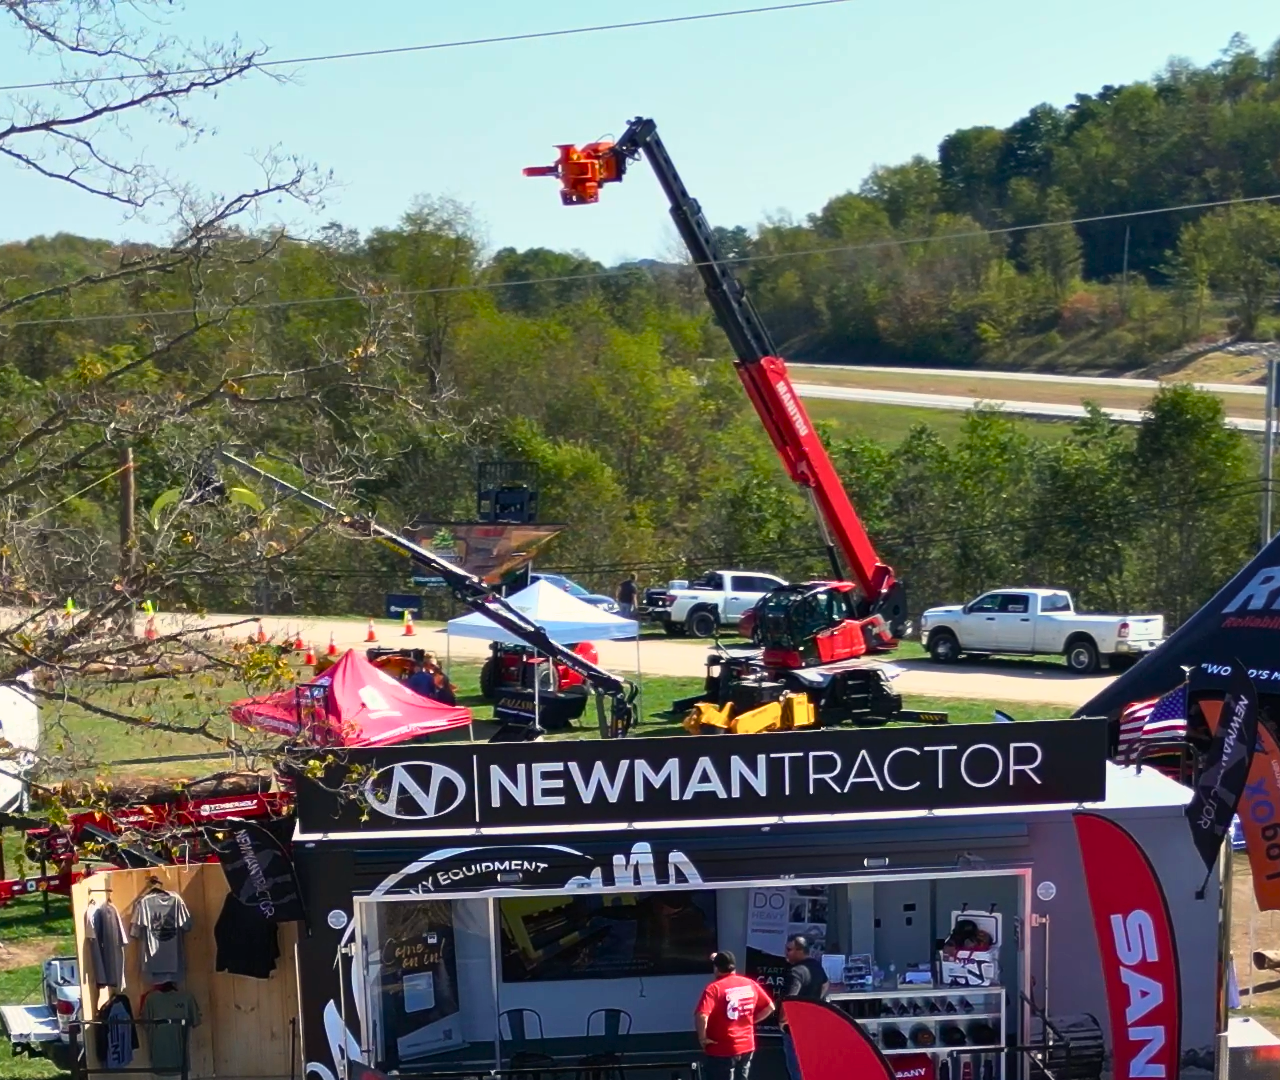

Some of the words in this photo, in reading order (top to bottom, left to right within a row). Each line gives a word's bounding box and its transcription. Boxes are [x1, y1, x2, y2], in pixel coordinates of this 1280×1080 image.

[776, 381, 809, 436] MANITOU
[1201, 663, 1269, 681] "WOD'S
[489, 740, 1043, 808] NEWMANTRACTOR
[438, 859, 549, 886] EQUIPMENT
[753, 891, 786, 910] DO
